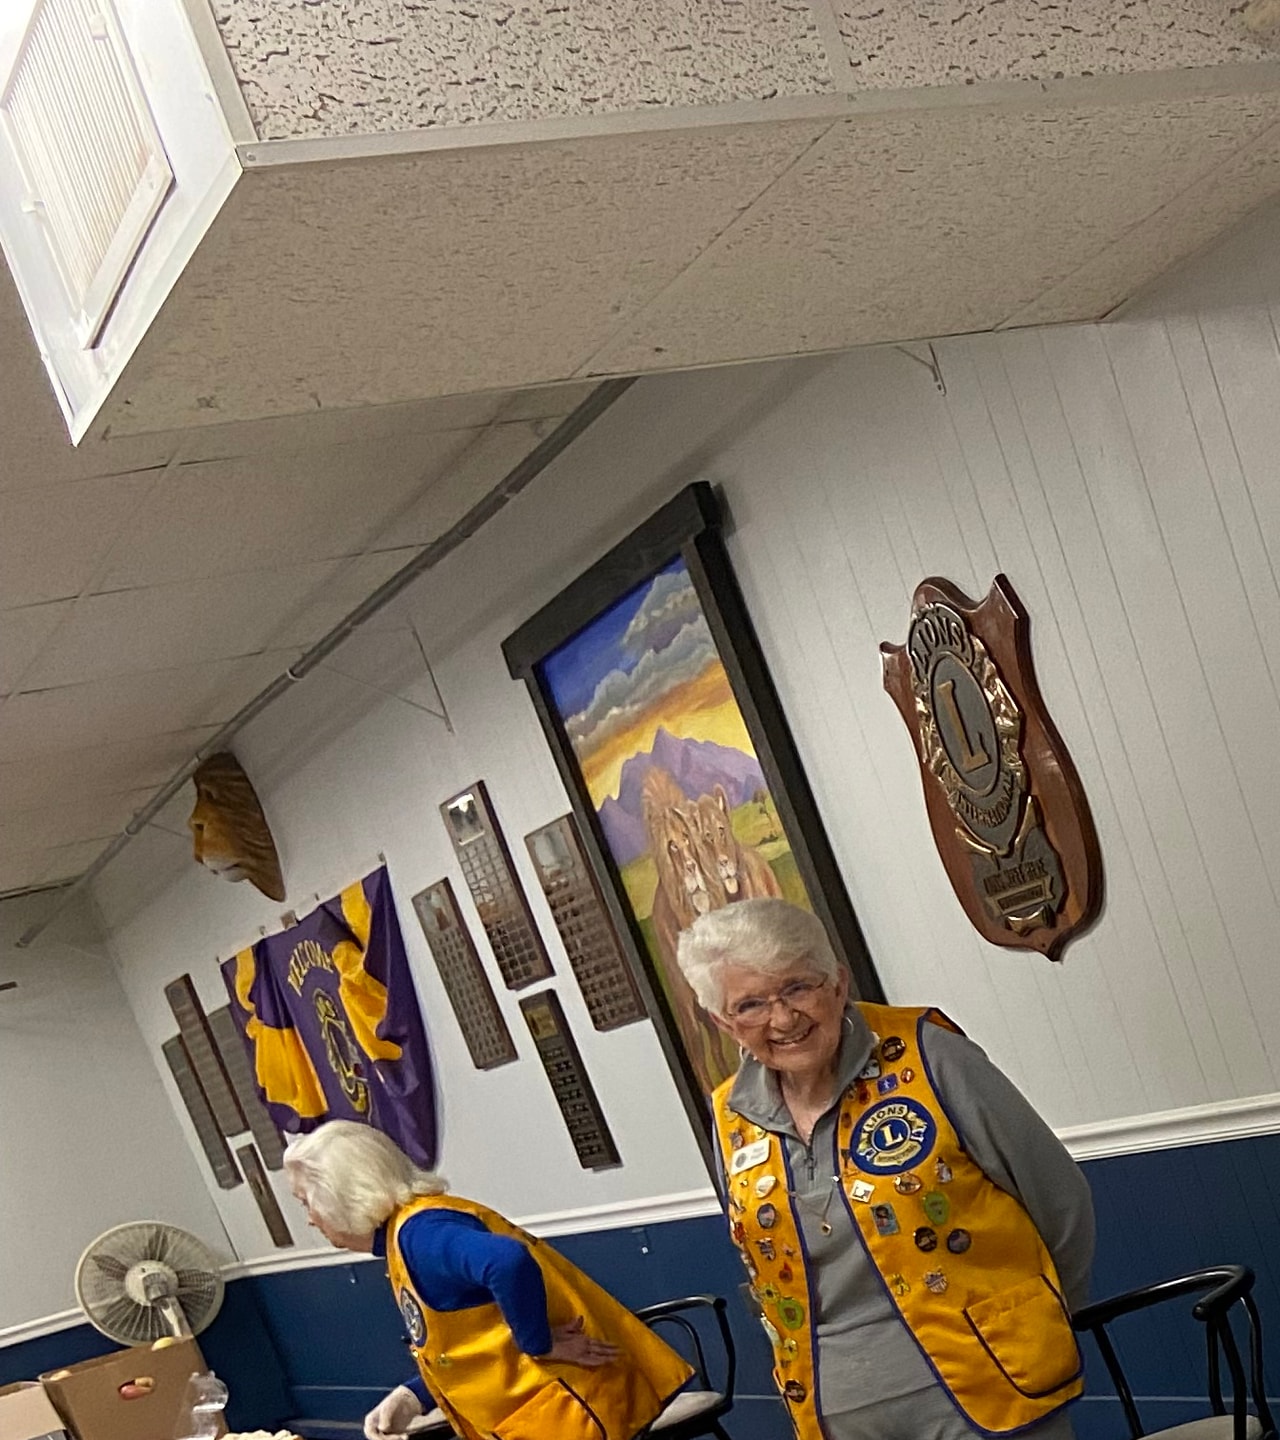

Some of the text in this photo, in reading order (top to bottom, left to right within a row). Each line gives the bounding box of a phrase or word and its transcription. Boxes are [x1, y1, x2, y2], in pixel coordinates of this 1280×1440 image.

[911, 615, 966, 684] LIONS
[936, 679, 992, 774] L
[865, 1106, 905, 1129] LIONS
[881, 1124, 904, 1147] L
